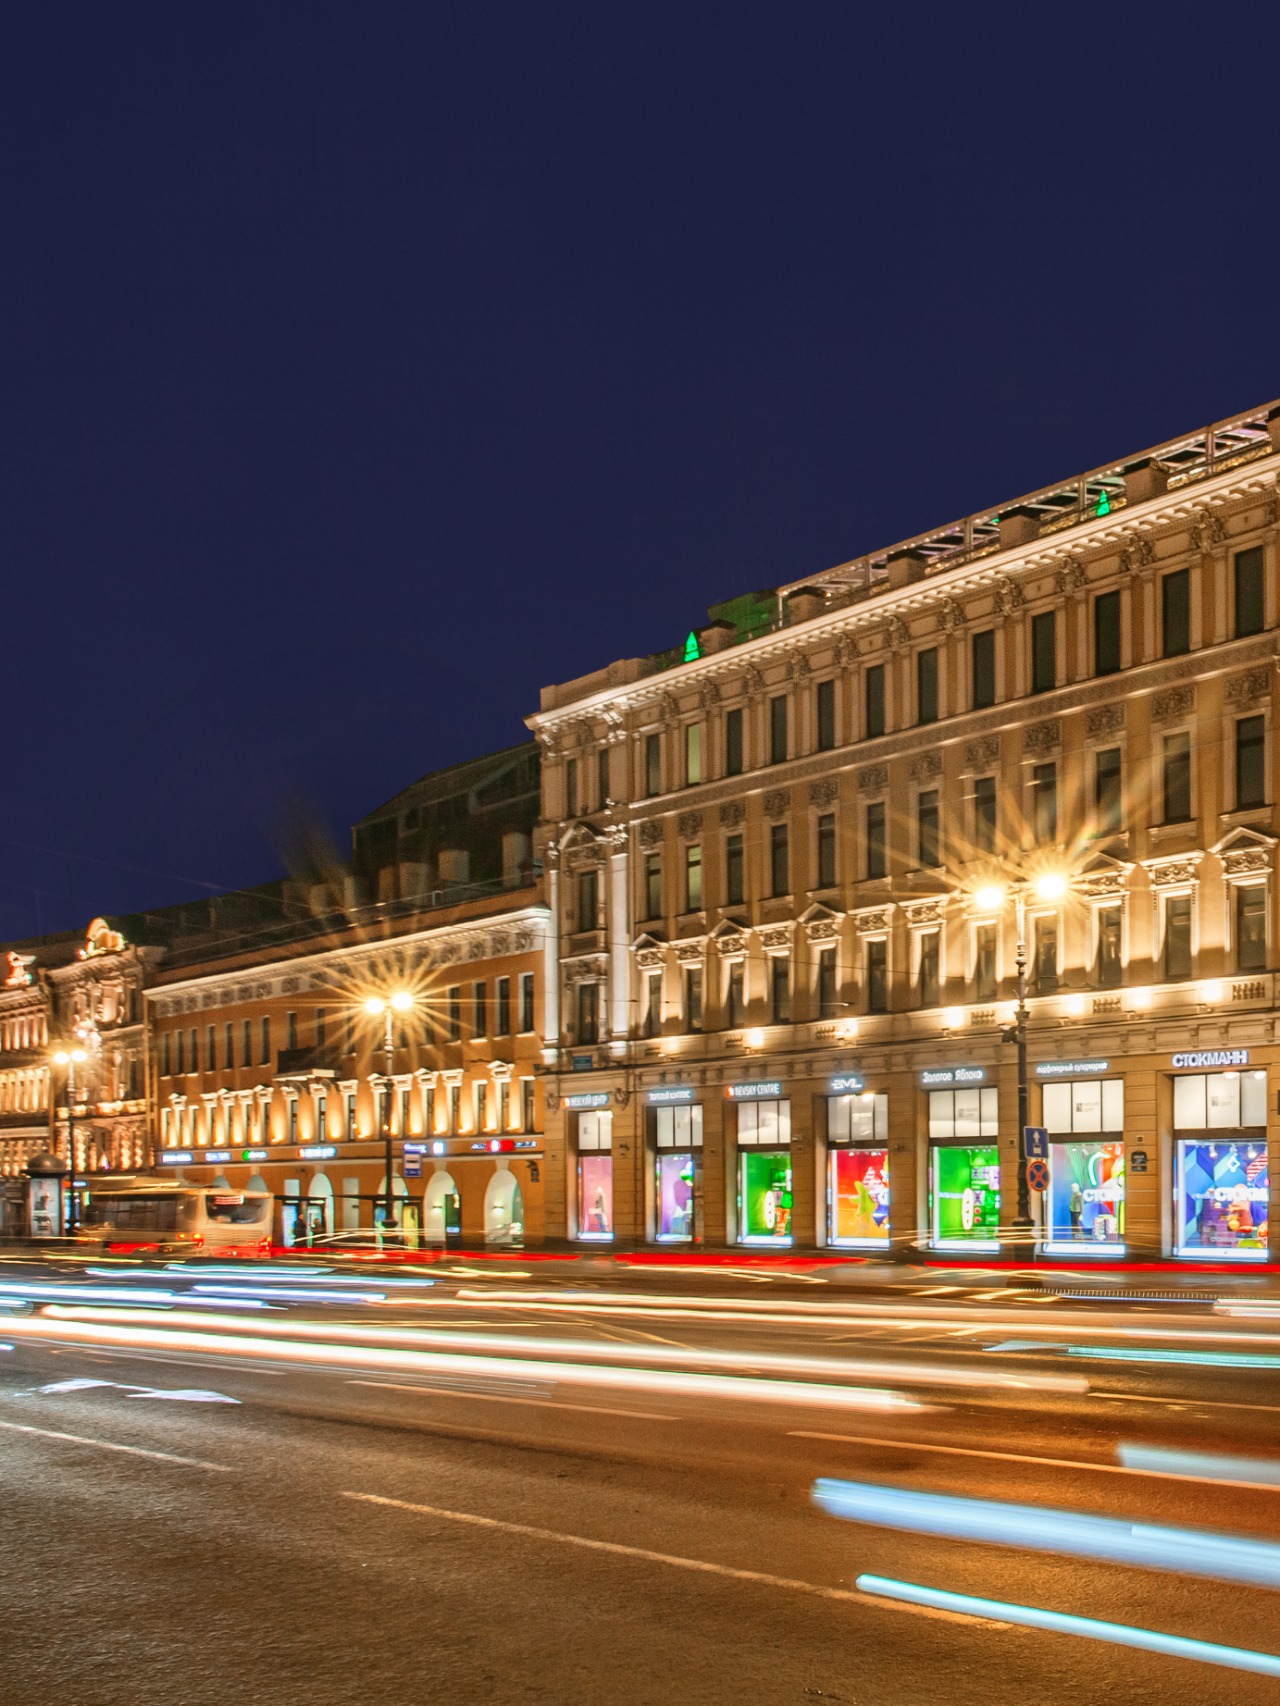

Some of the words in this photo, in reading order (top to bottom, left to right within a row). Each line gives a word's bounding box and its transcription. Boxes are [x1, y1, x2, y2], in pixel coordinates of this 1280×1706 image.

[1172, 1049, 1248, 1068] СТОКМАНН
[922, 1071, 954, 1083] Золотое
[955, 1068, 984, 1081] Яблоко
[757, 1083, 780, 1095] CENTRE
